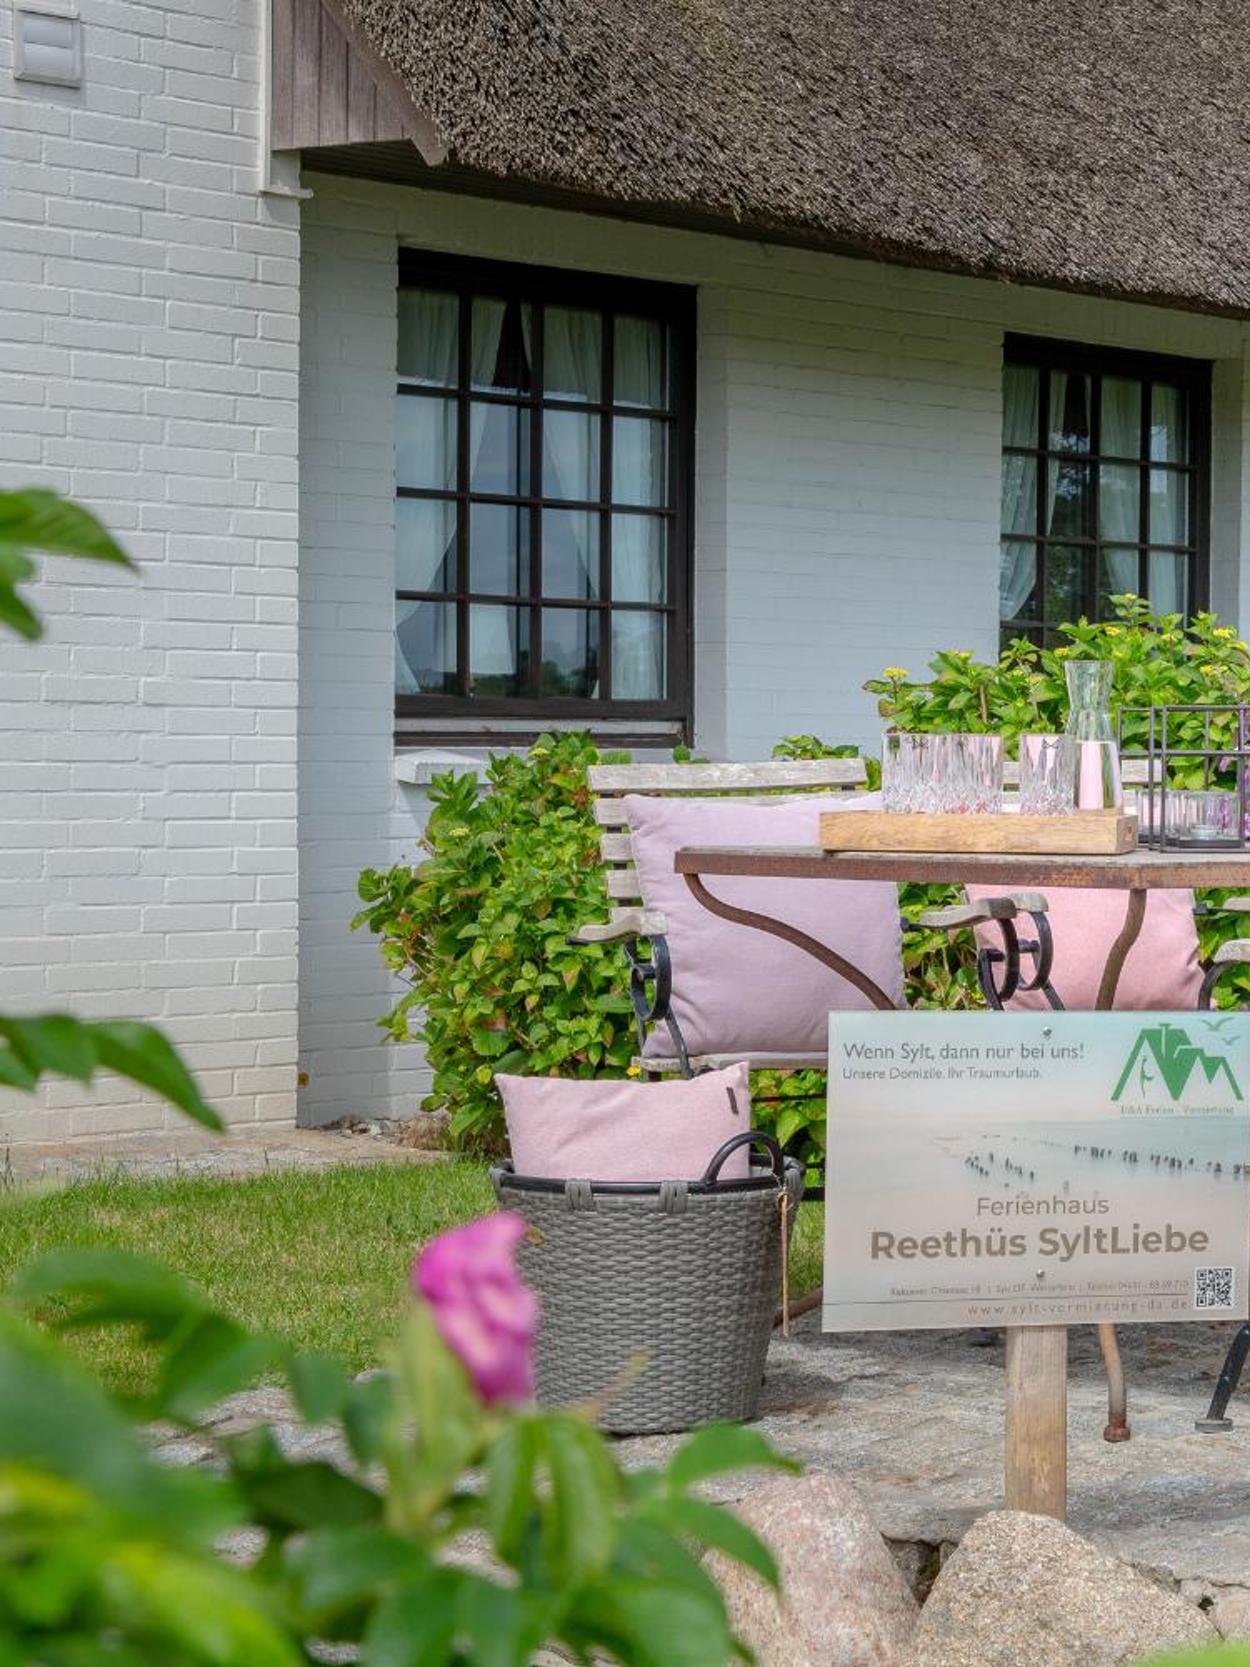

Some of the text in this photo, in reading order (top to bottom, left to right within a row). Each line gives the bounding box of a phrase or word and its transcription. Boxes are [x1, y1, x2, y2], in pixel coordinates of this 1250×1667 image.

[843, 1042, 1085, 1064] Wenn Sylt, dann nur bei uns!
[843, 1067, 886, 1080] Unsere
[947, 1066, 963, 1079] Ihr
[976, 1195, 1110, 1217] Ferienhaus
[870, 1223, 1210, 1263] Reethüs SyltLiebe
